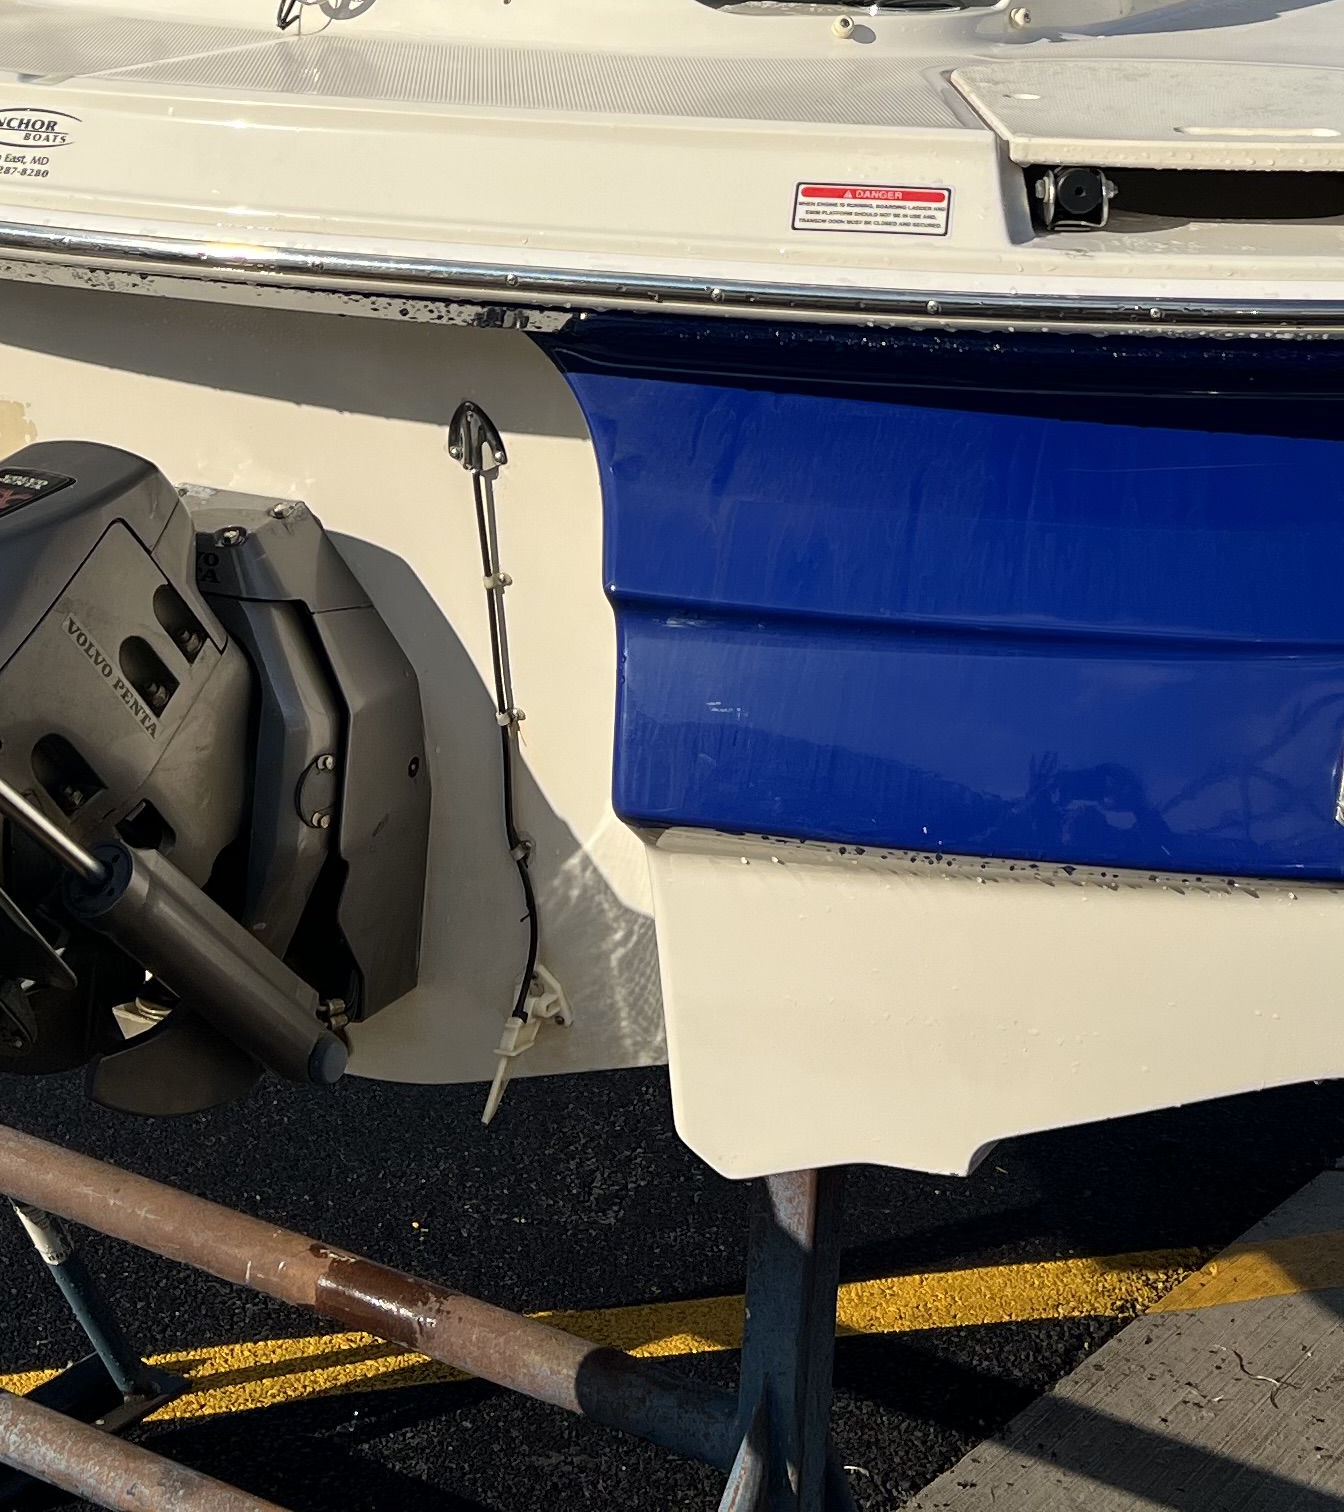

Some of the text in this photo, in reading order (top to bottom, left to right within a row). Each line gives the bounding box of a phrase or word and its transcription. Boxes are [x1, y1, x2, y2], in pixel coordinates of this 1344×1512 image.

[23, 133, 67, 143] BOATS
[4, 153, 27, 165] East,
[30, 156, 50, 165] MD
[856, 190, 903, 199] DANGER
[67, 617, 157, 739] VOLVO PENTA
